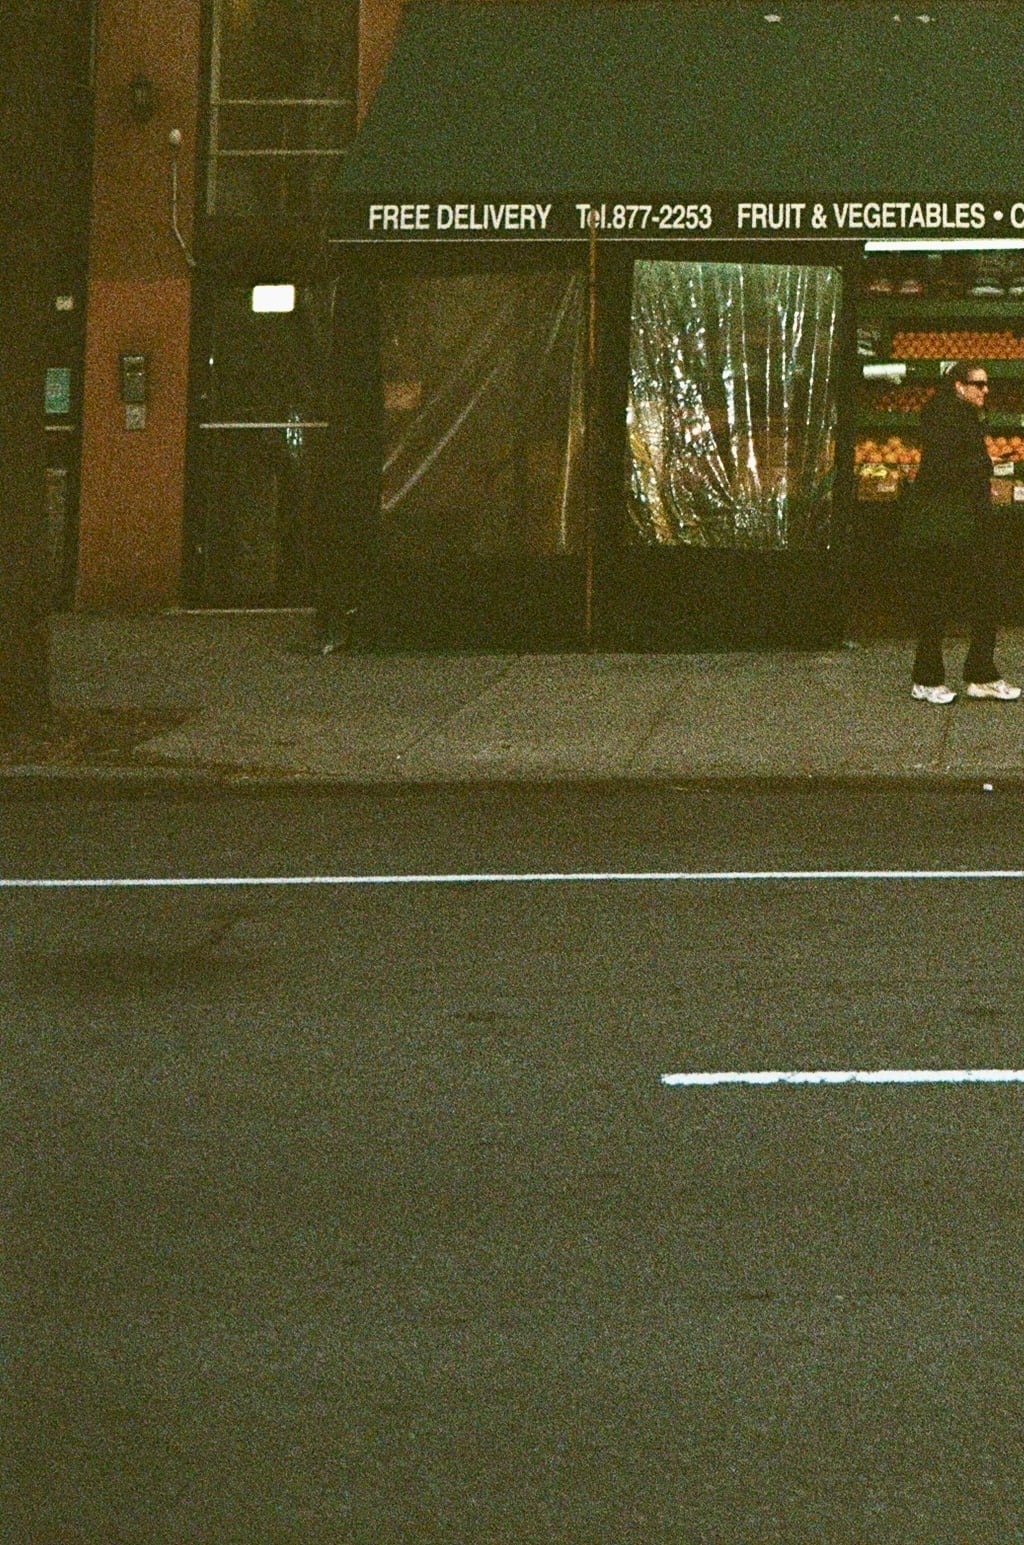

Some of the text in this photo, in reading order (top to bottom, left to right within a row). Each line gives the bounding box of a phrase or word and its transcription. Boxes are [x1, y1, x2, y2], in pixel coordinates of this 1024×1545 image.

[369, 204, 552, 230] FREE DELIVERY
[737, 202, 806, 229] FRUIT
[811, 202, 827, 229] &
[832, 202, 986, 229] VEGETABLES
